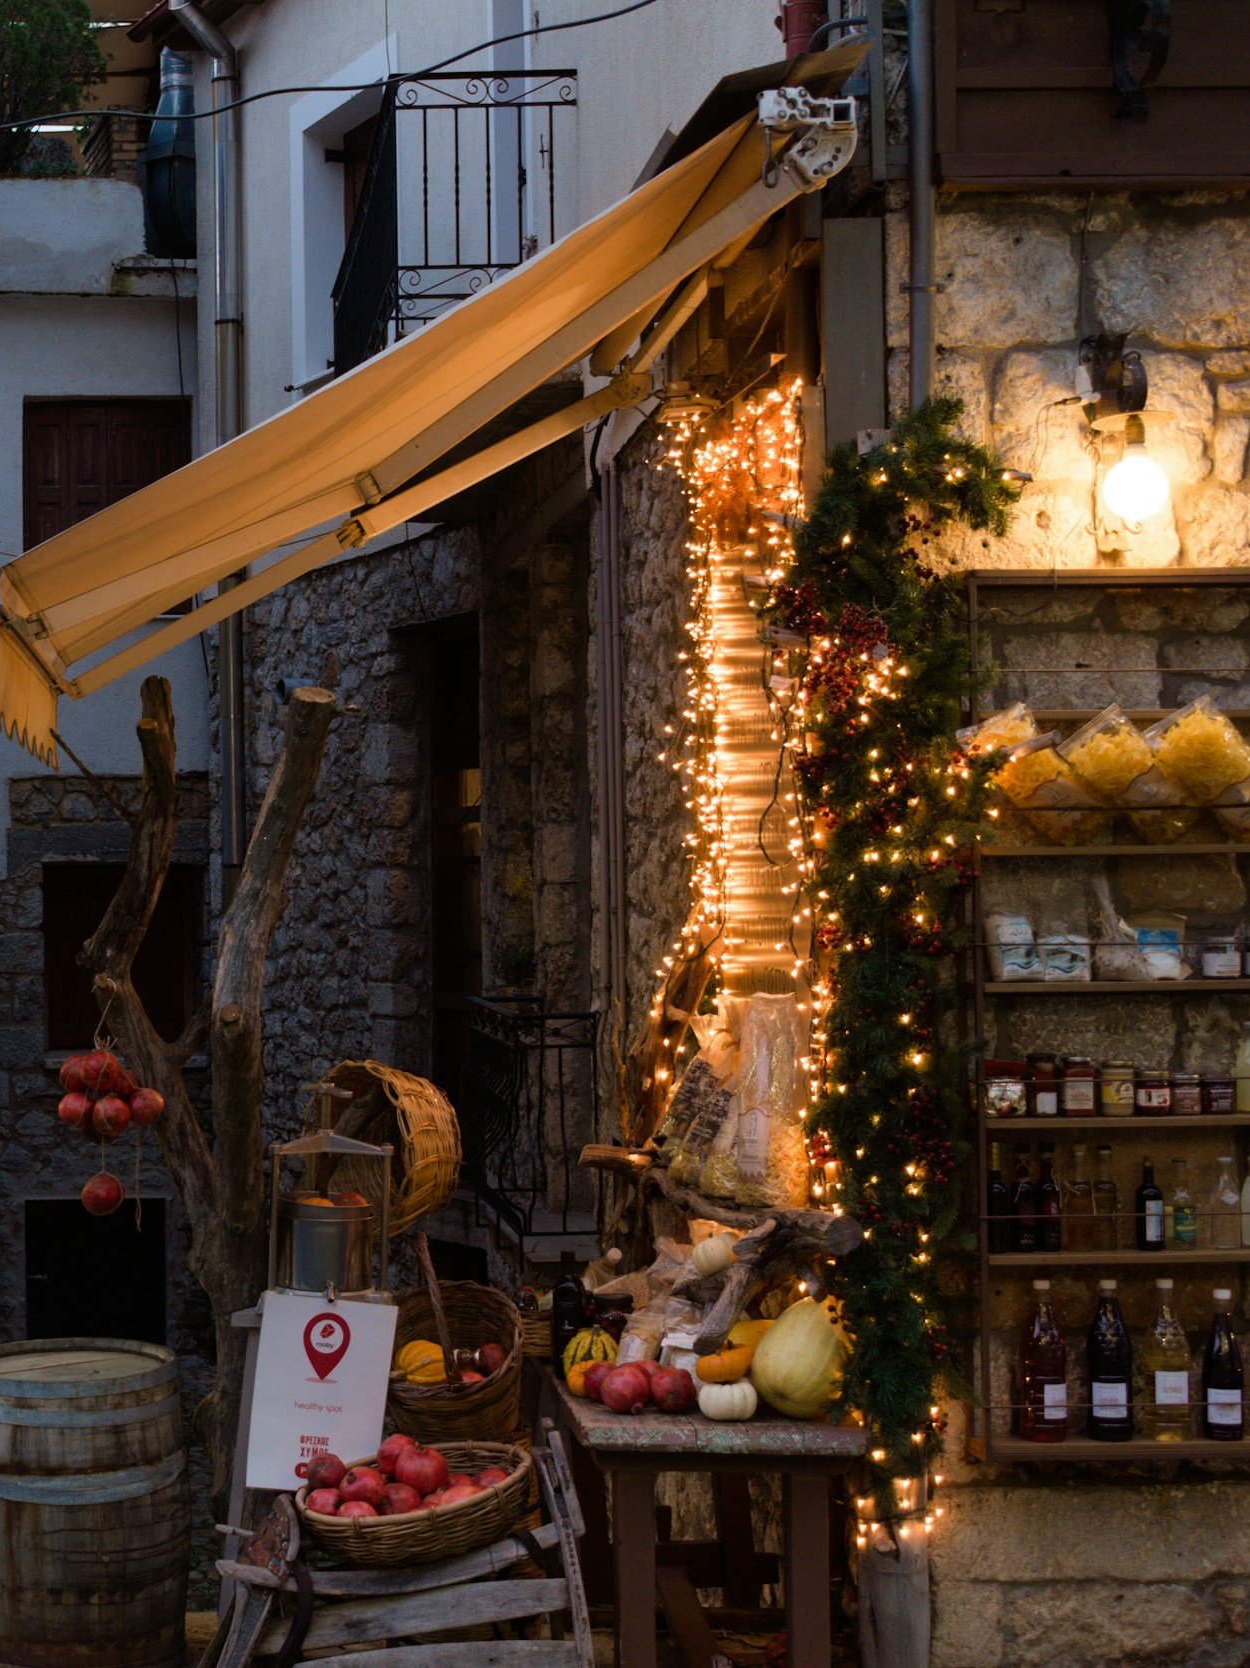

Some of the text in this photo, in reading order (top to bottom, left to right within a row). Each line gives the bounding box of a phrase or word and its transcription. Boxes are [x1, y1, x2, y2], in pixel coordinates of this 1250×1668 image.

[294, 1401, 342, 1413] healthy spot
[300, 1435, 329, 1446] ΦΡΕΣΚΟΣ
